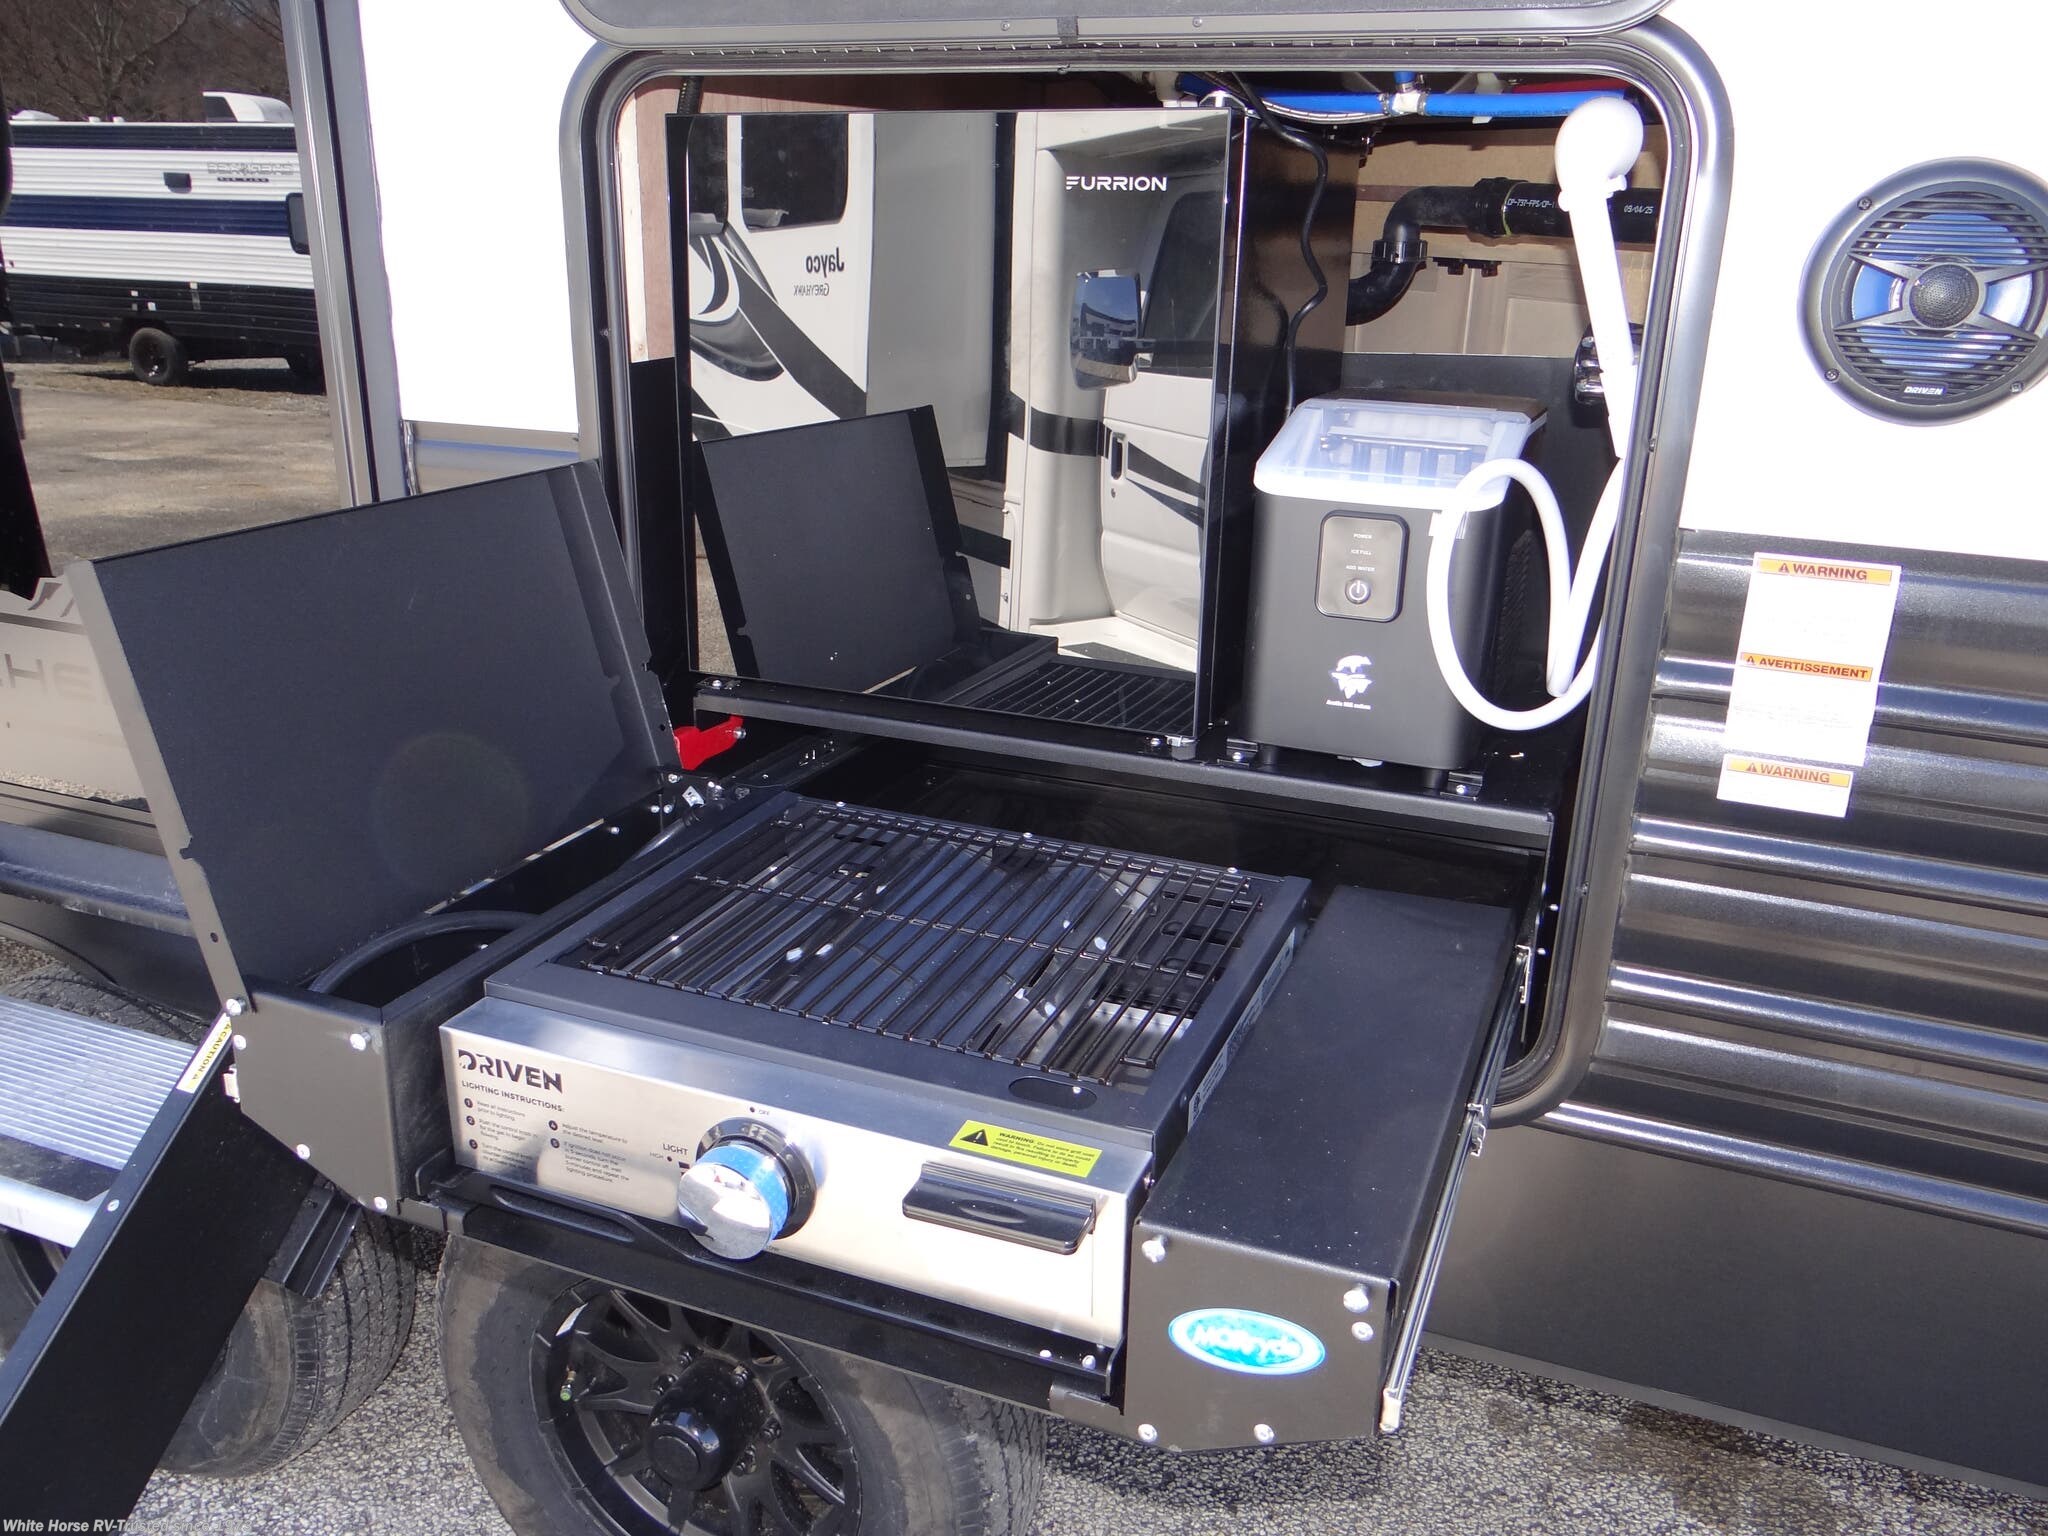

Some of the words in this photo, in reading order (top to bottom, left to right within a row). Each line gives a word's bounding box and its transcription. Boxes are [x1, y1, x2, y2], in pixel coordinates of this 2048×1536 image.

[1066, 176, 1167, 191] FURRION
[1904, 386, 1944, 395] DRIVEN
[1792, 564, 1868, 581] WARNING
[1760, 658, 1868, 679] AVERTISSEMENT
[1760, 764, 1830, 783] WARNING
[458, 1049, 562, 1094] DRIVEN
[462, 1080, 500, 1096] LIGHTING
[662, 1143, 688, 1156] LIGHT
